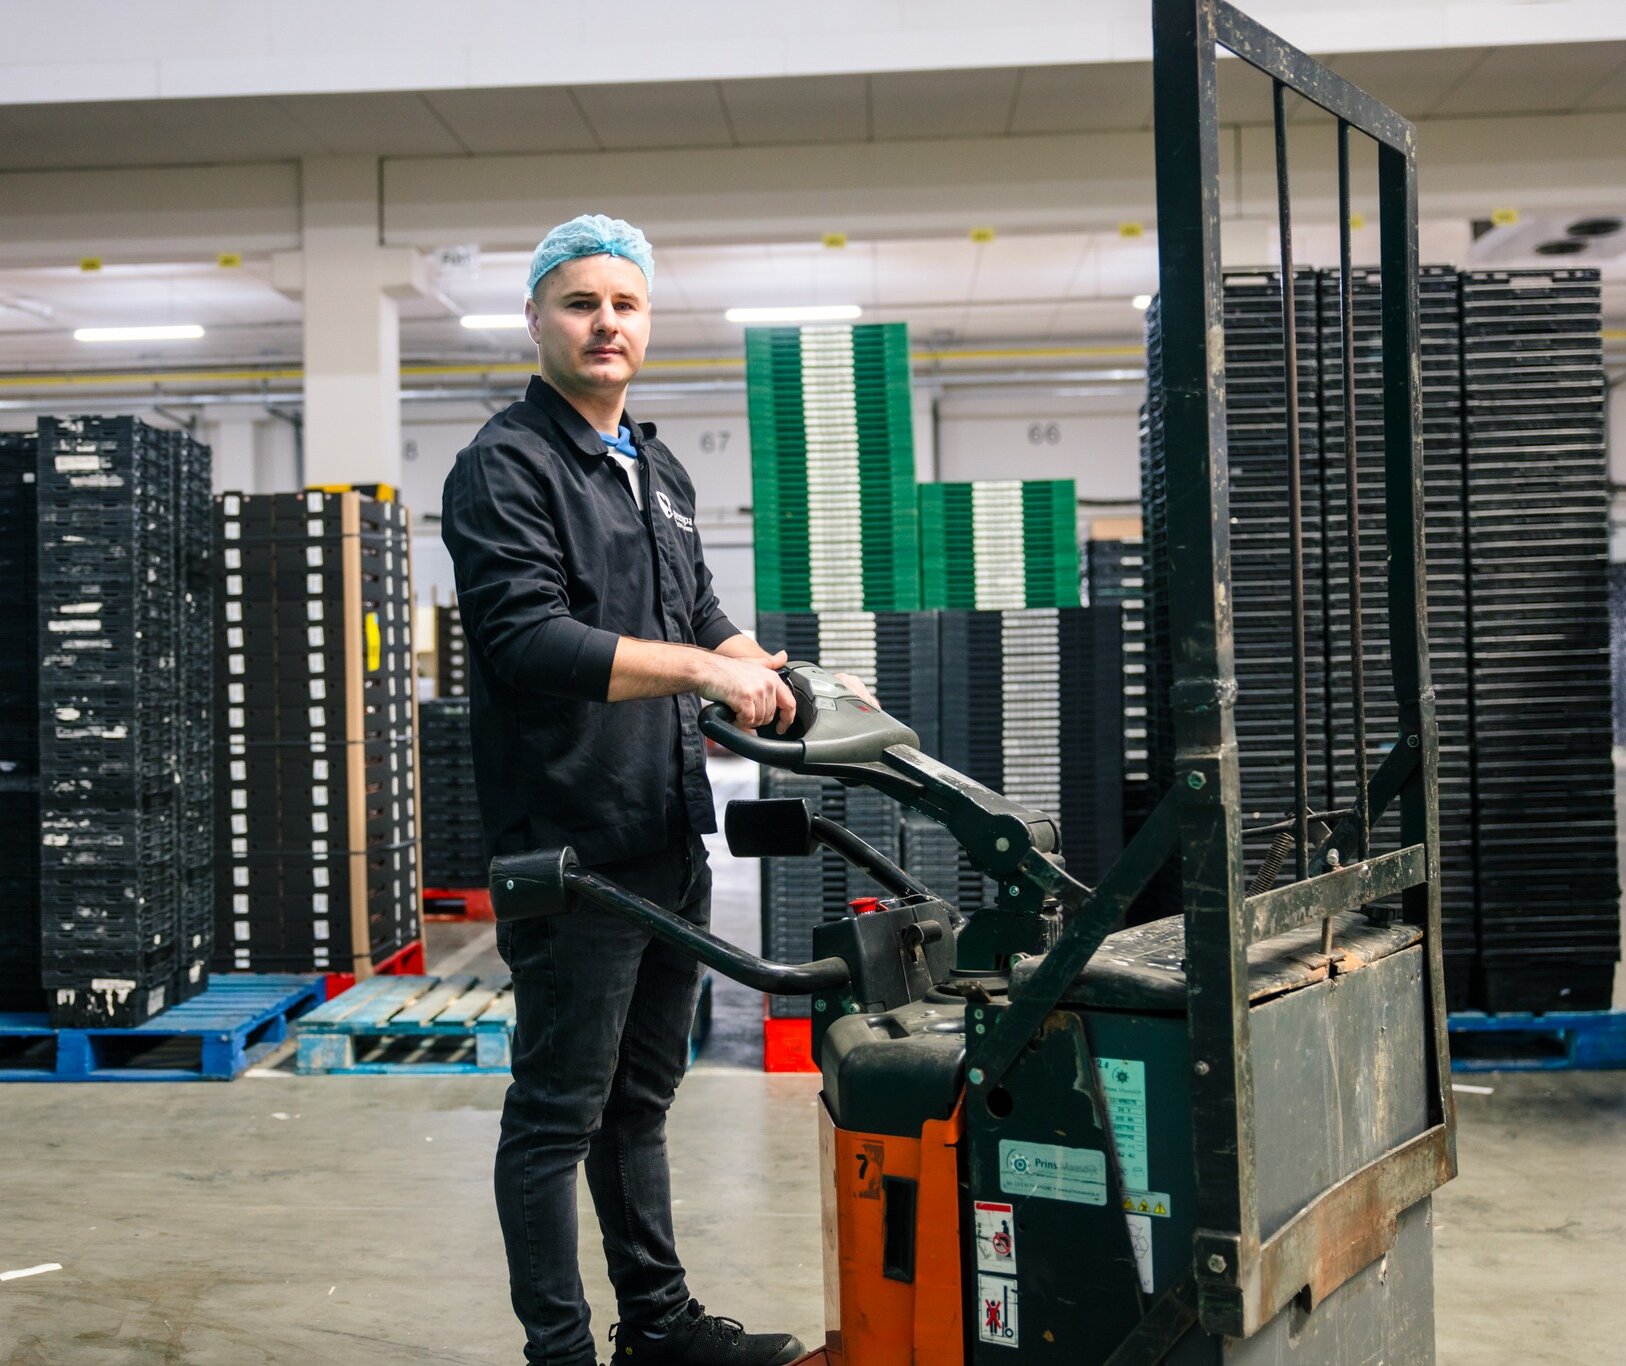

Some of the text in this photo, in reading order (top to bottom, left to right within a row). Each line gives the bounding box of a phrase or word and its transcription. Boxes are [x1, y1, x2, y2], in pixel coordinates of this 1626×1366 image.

[699, 430, 731, 454] 67
[1027, 421, 1061, 446] 66
[401, 439, 418, 462] 8
[855, 1154, 868, 1179] 7
[1035, 1158, 1058, 1170] Prins
